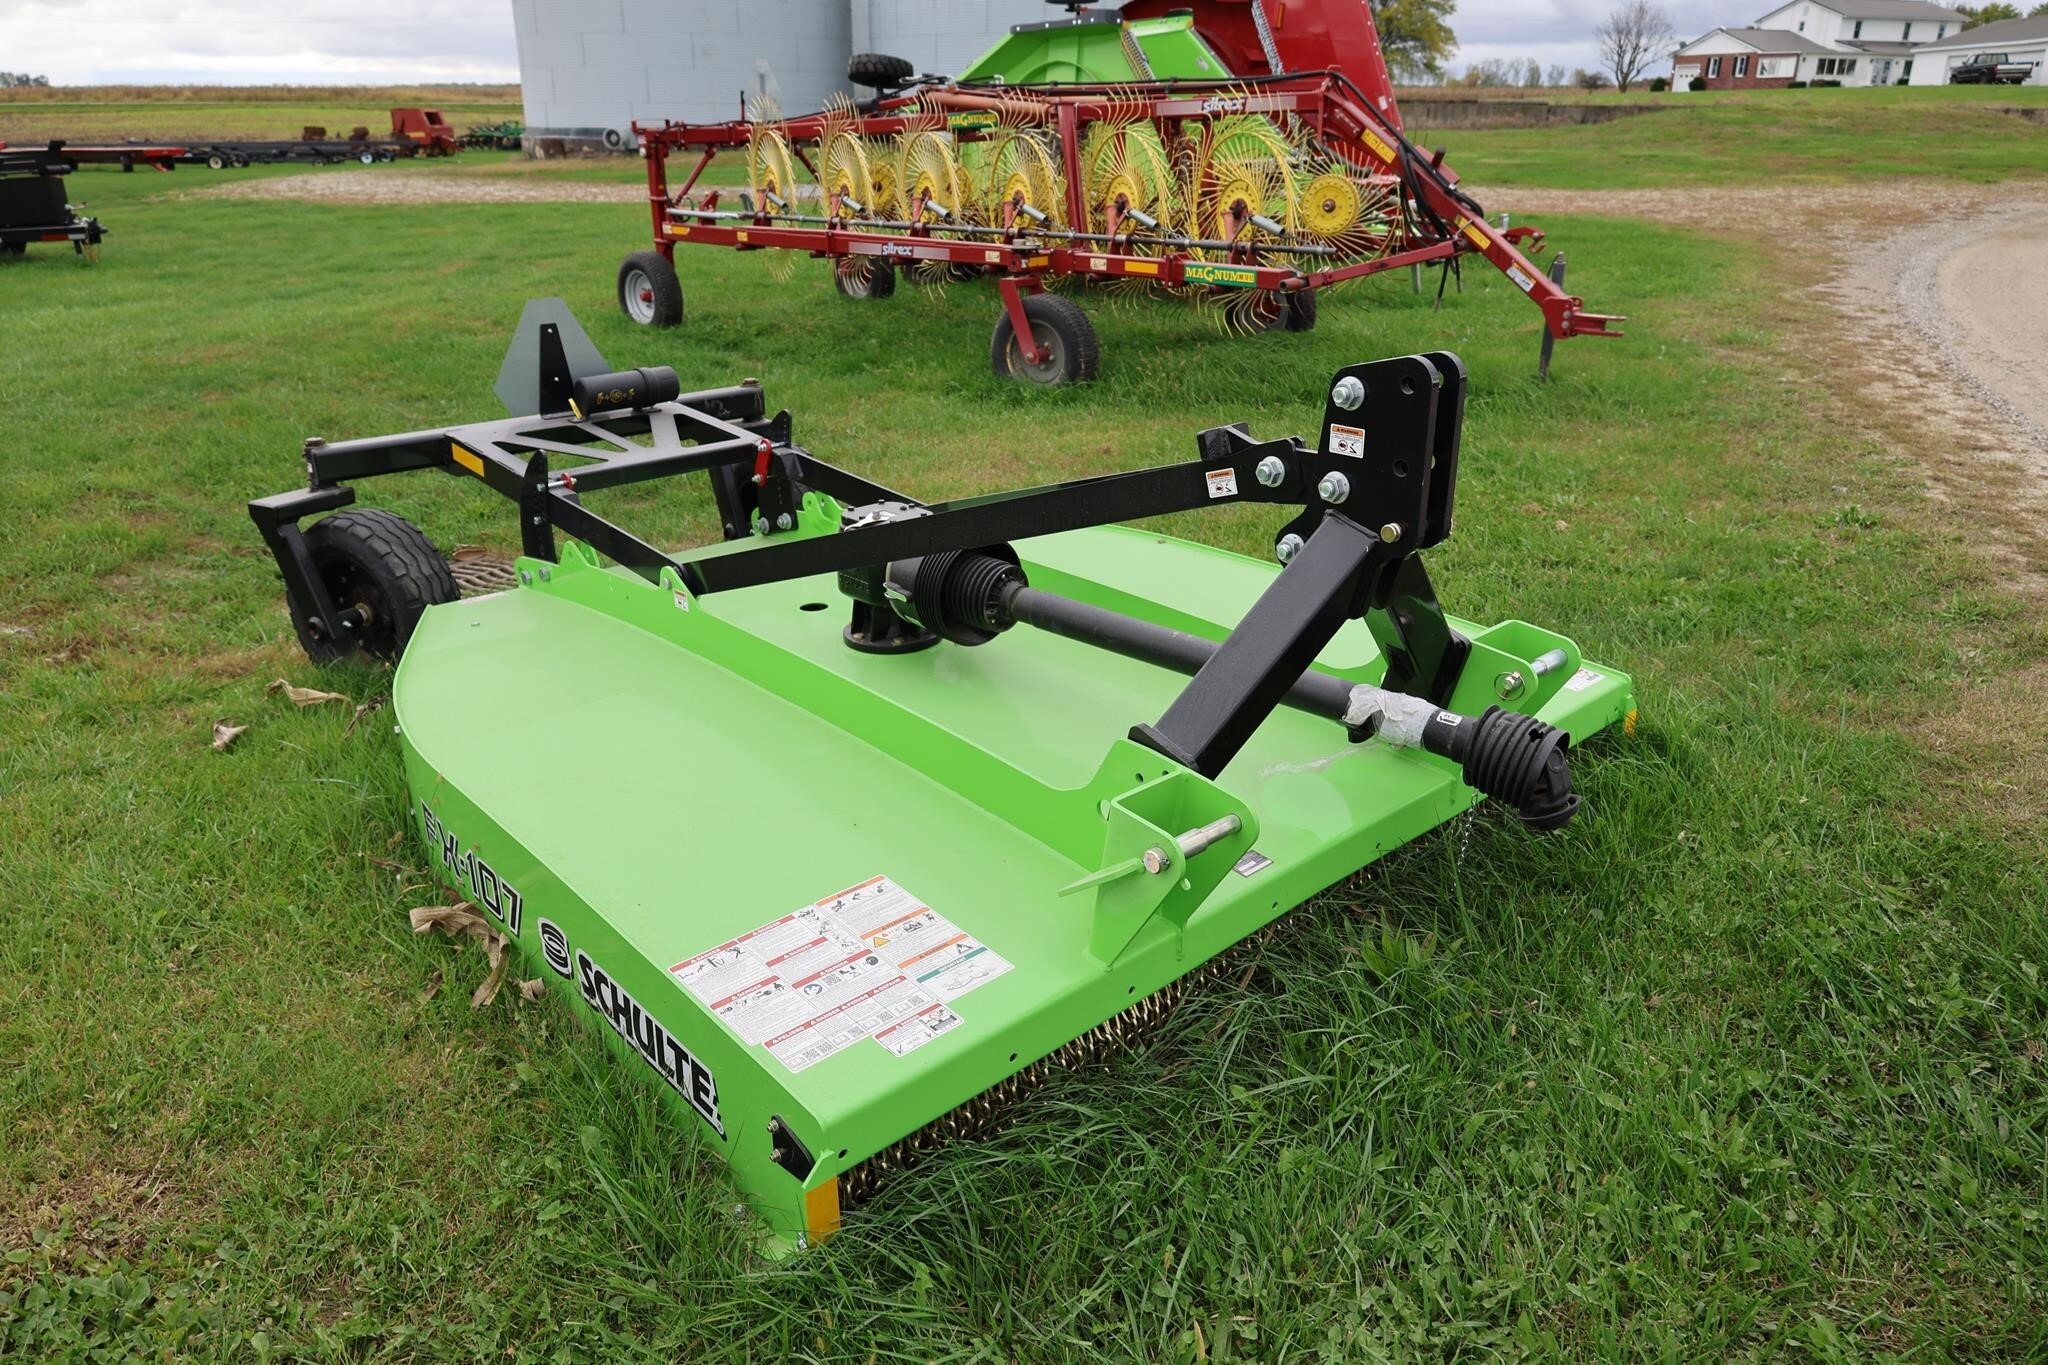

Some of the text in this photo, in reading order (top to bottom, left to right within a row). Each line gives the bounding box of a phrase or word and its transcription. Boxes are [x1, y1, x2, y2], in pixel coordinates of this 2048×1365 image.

[881, 240, 913, 256] sitrex
[1185, 266, 1240, 283] MAGNUM
[735, 983, 763, 997] DANGER
[577, 950, 718, 1124] SCHULTE
